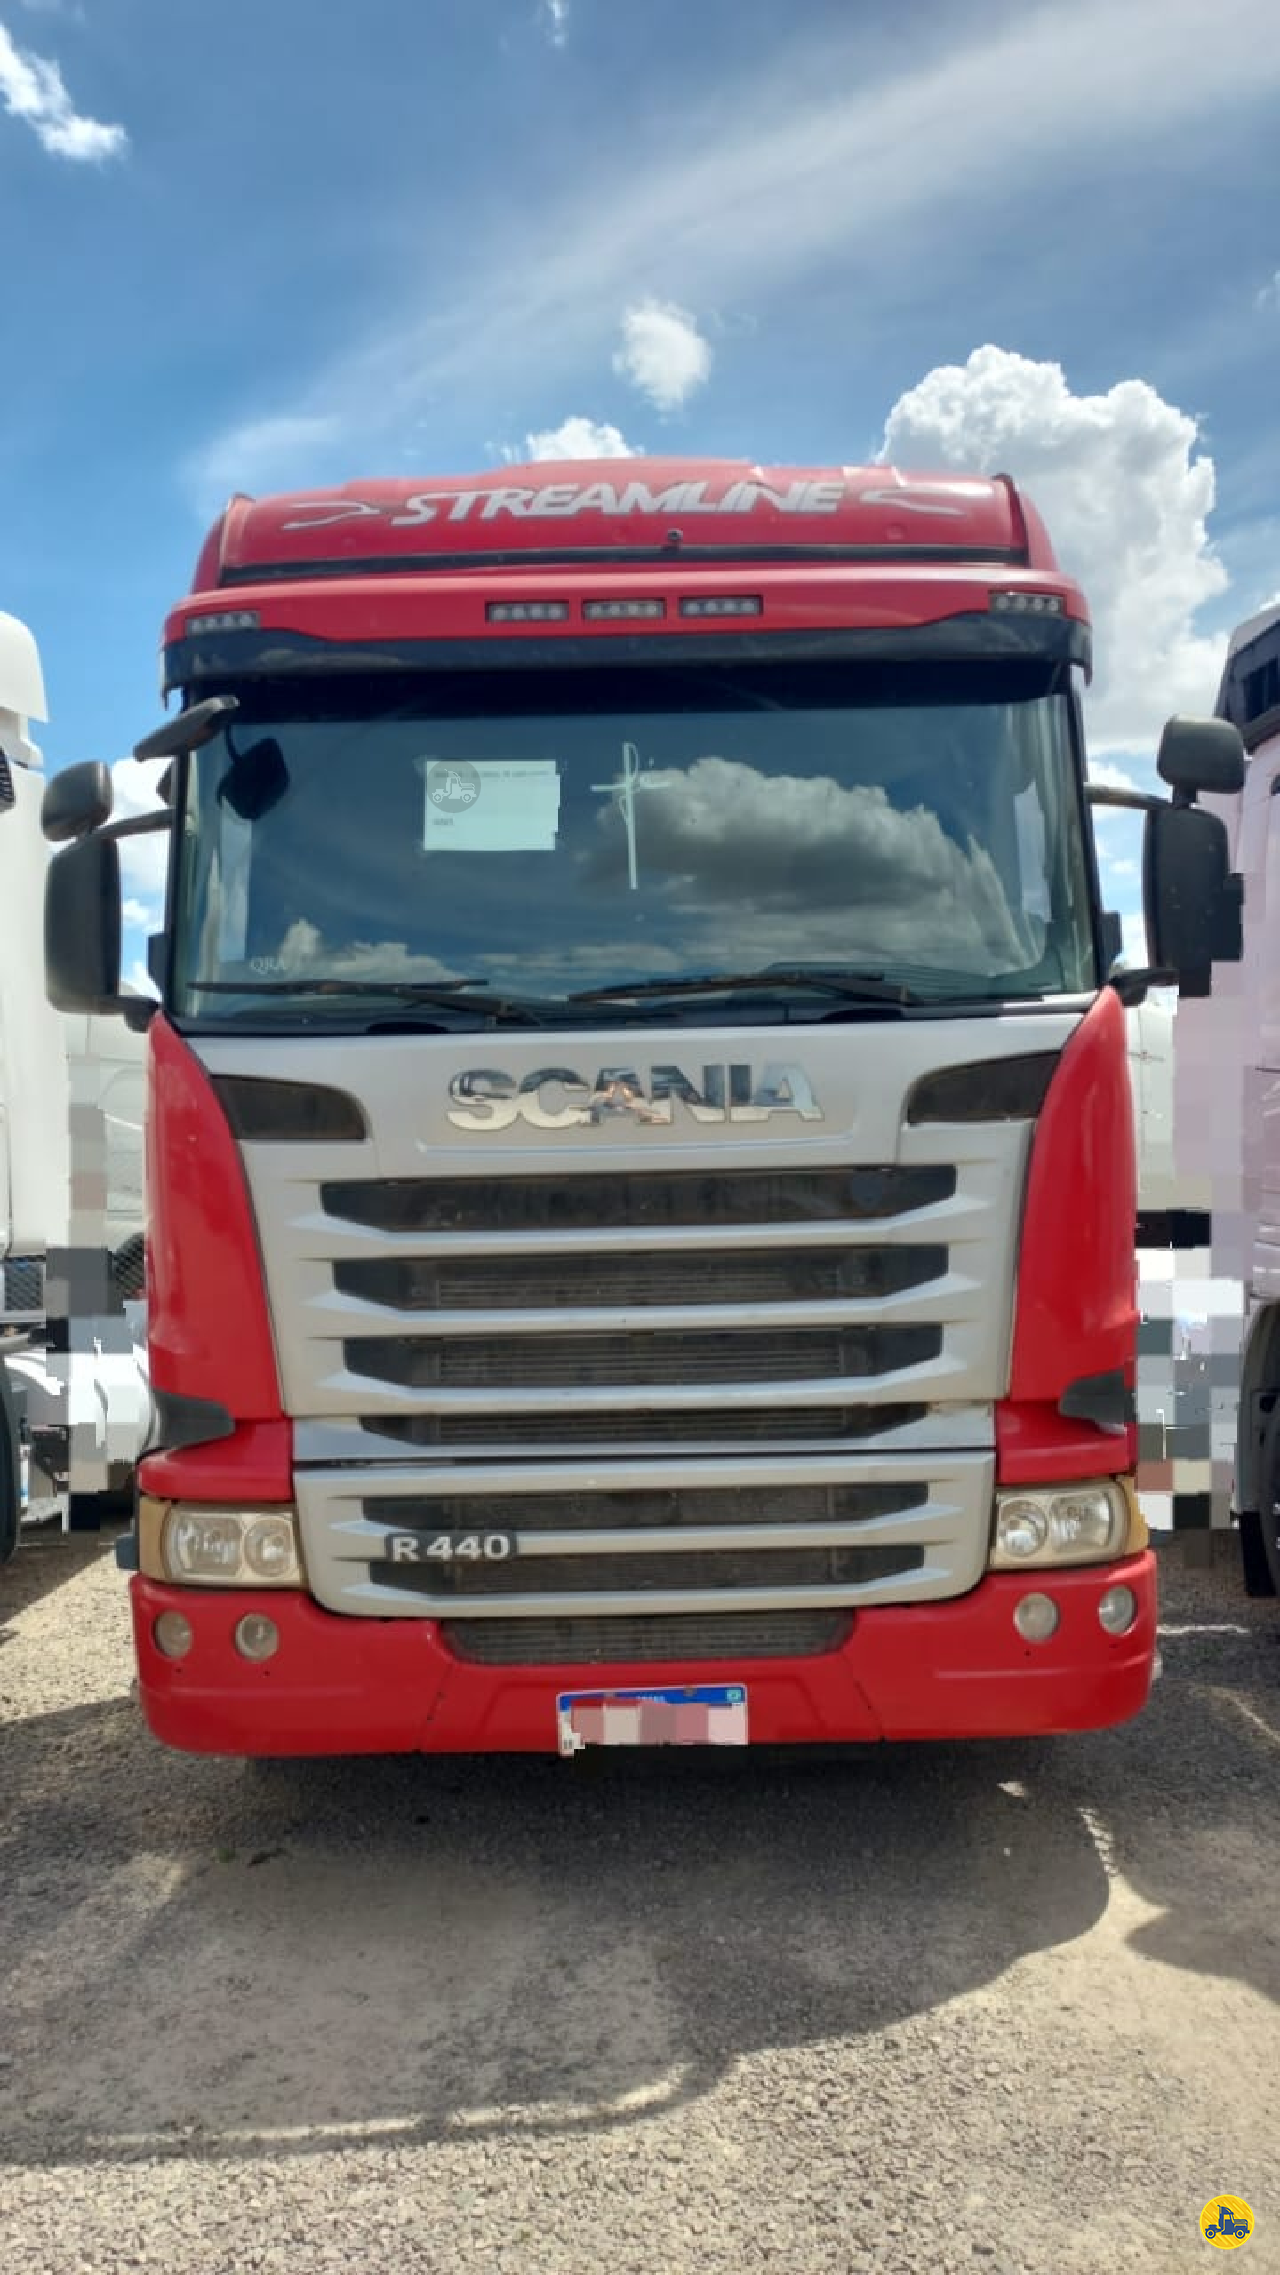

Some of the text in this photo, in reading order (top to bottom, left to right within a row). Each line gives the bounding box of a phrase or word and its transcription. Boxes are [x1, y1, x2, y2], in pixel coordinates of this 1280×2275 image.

[390, 482, 844, 526] STREAMLINE
[447, 1065, 825, 1131] SCANIA
[392, 1535, 510, 1561] R 440
